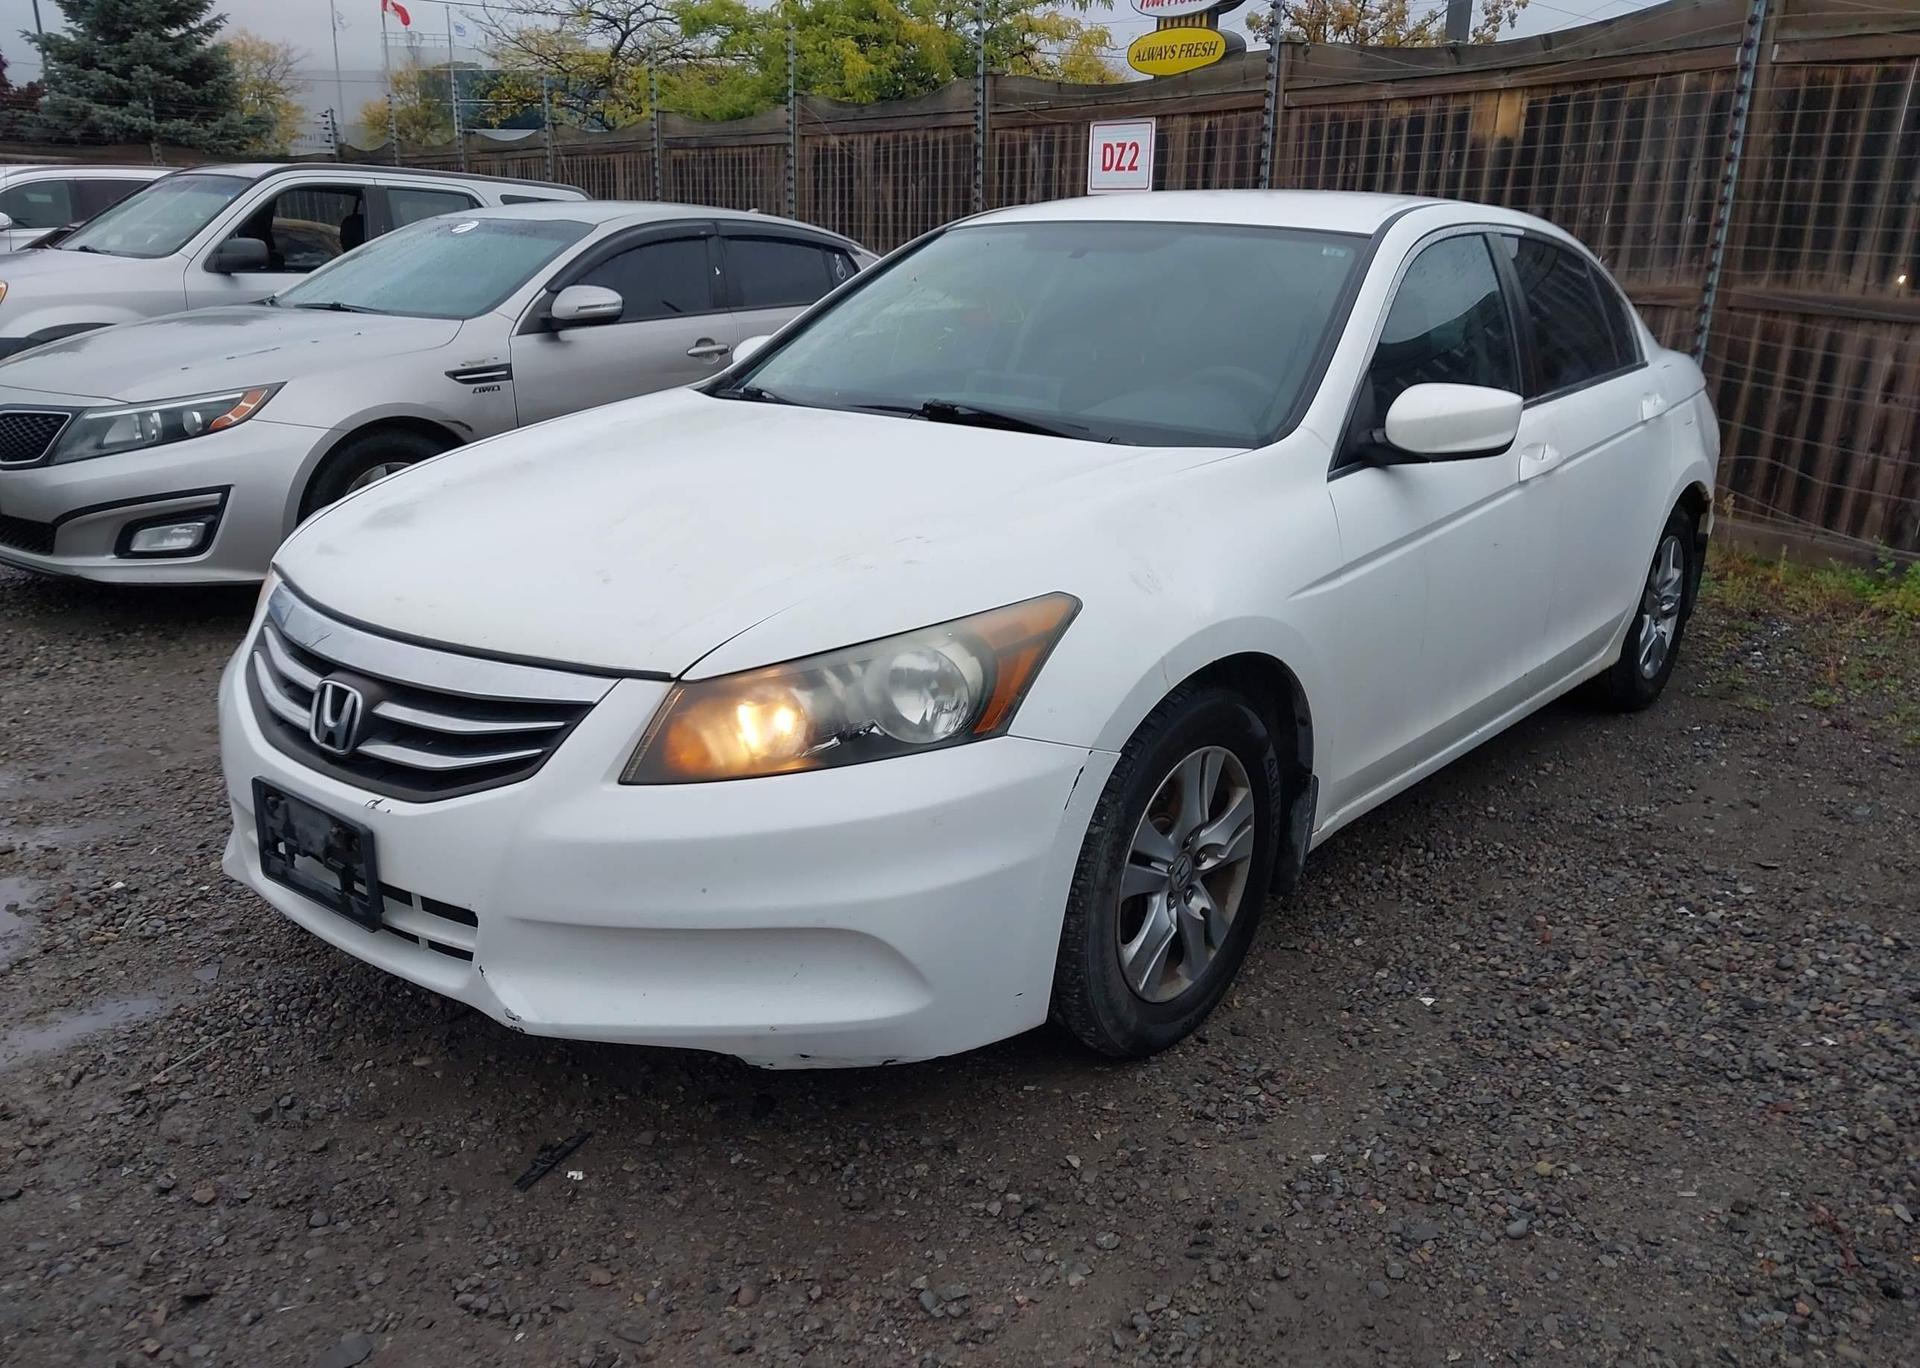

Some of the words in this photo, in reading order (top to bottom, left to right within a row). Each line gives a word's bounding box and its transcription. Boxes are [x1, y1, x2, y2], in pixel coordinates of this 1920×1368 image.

[1133, 44, 1177, 63] ALWAYS
[1178, 41, 1219, 59] FRESH
[1101, 141, 1140, 172] DZ2
